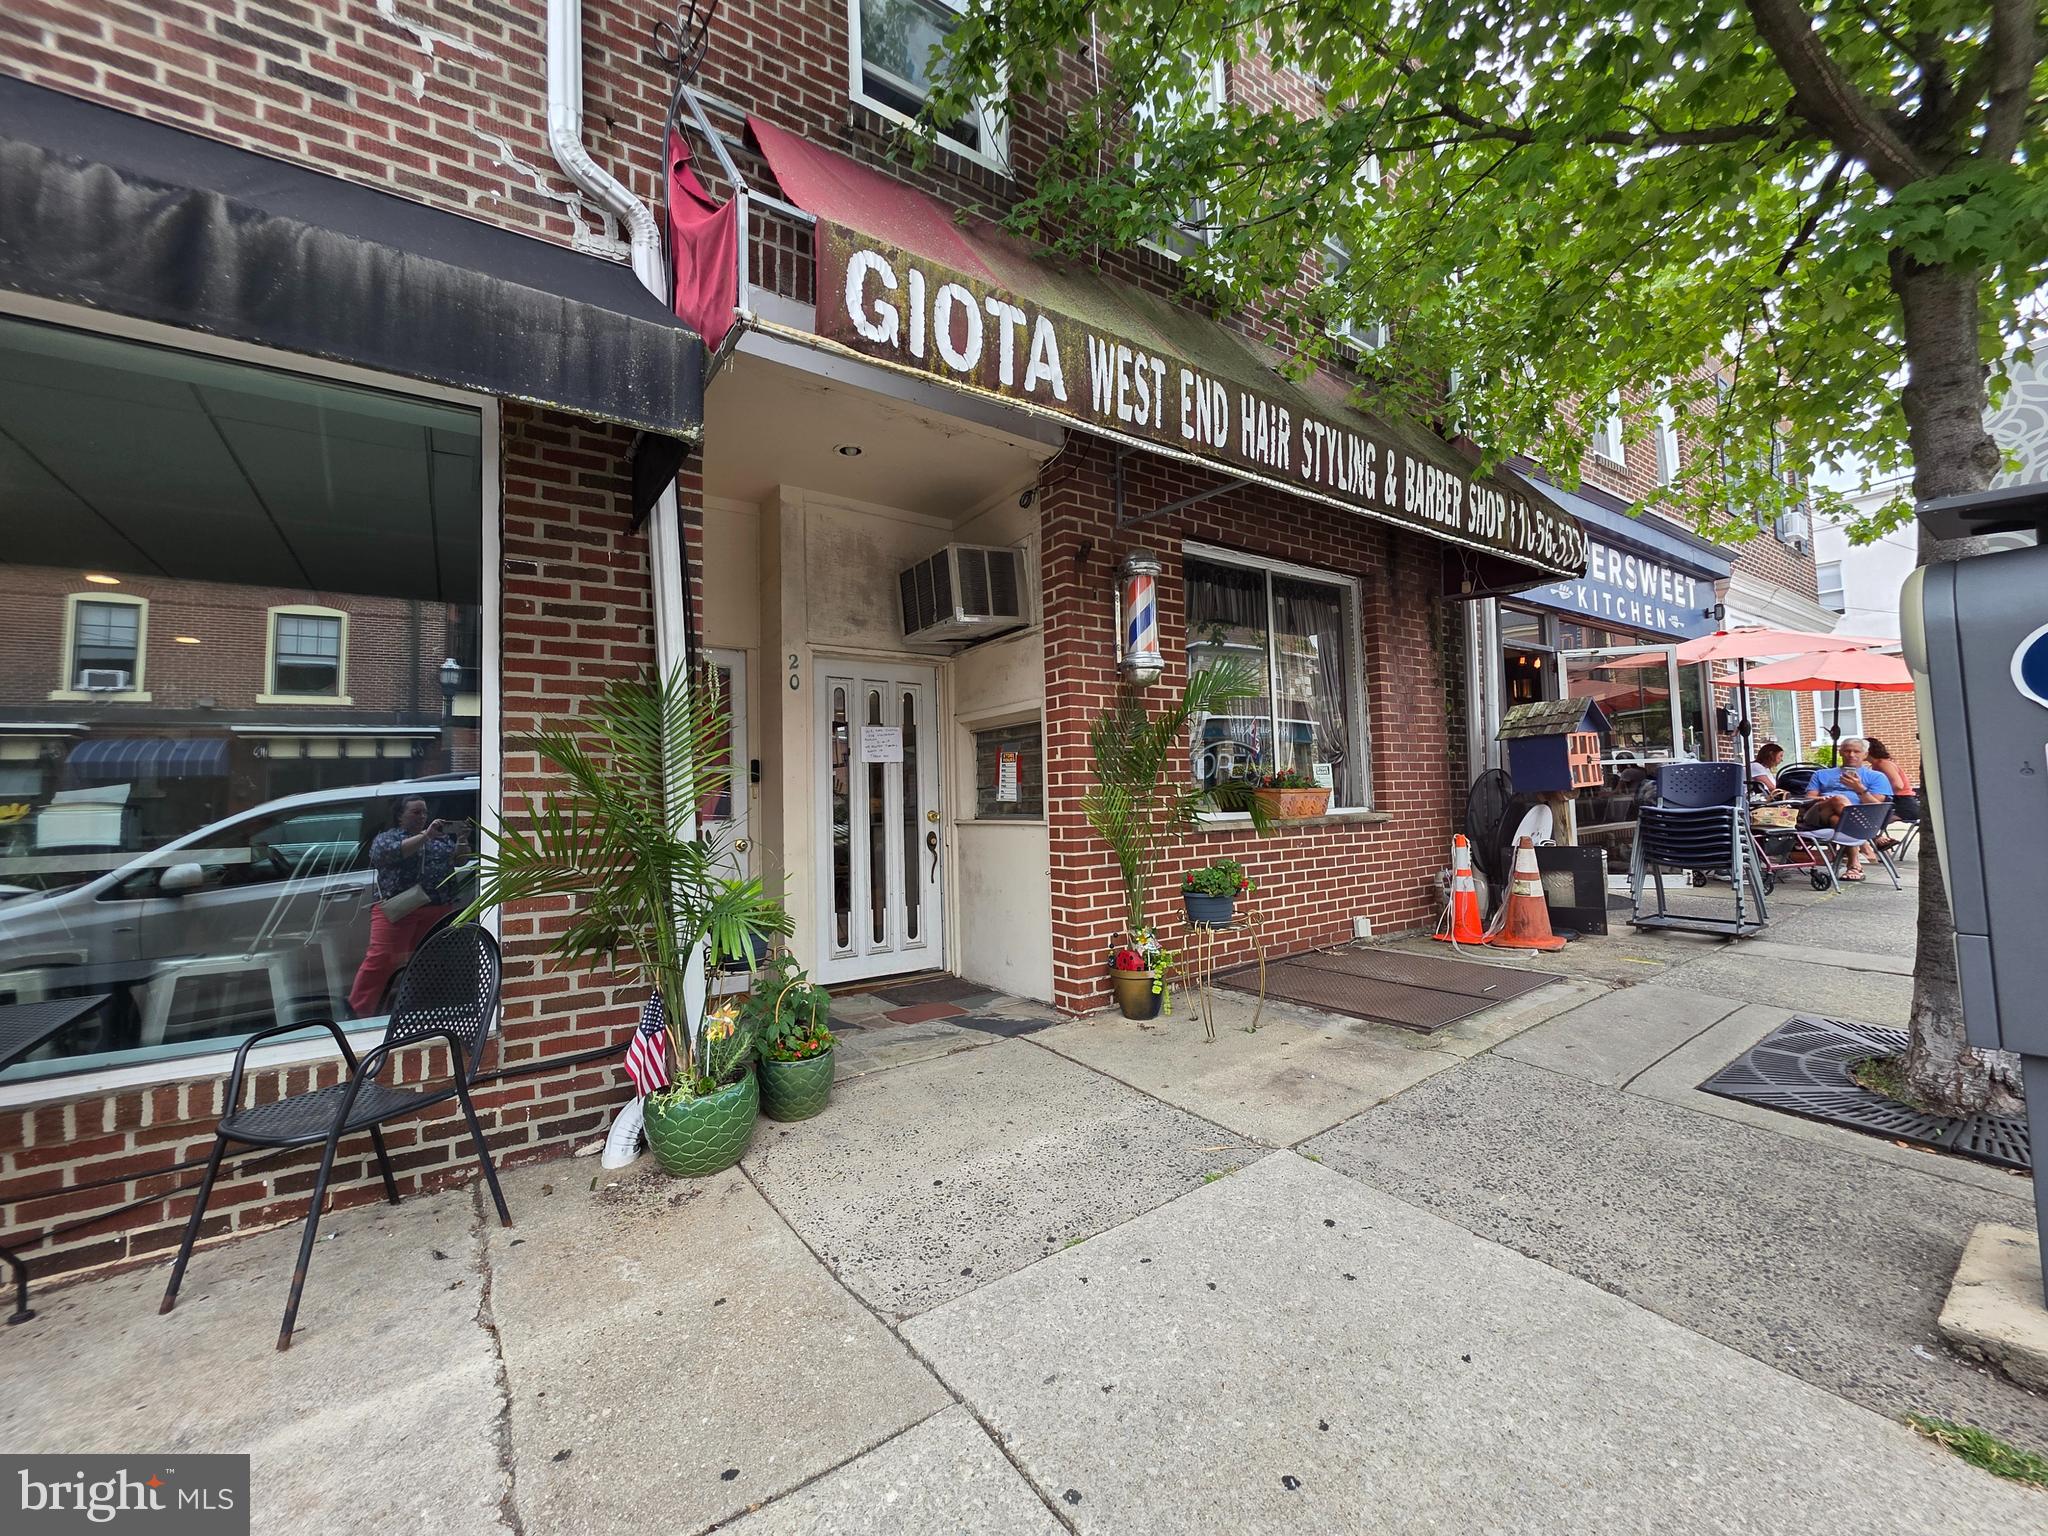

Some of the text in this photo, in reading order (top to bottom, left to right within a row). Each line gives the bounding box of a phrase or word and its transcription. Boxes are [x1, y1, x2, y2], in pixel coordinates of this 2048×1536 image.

[846, 249, 1068, 402] GIOTA
[1088, 333, 1166, 429] WEST
[1180, 368, 1229, 449] END
[1241, 391, 1291, 471] HAIR
[1301, 417, 1376, 500] STYLING
[1384, 449, 1398, 508] &
[1404, 455, 1462, 529] BARBER
[1468, 482, 1505, 540] SHOP
[1577, 585, 1667, 630] KITCHEN
